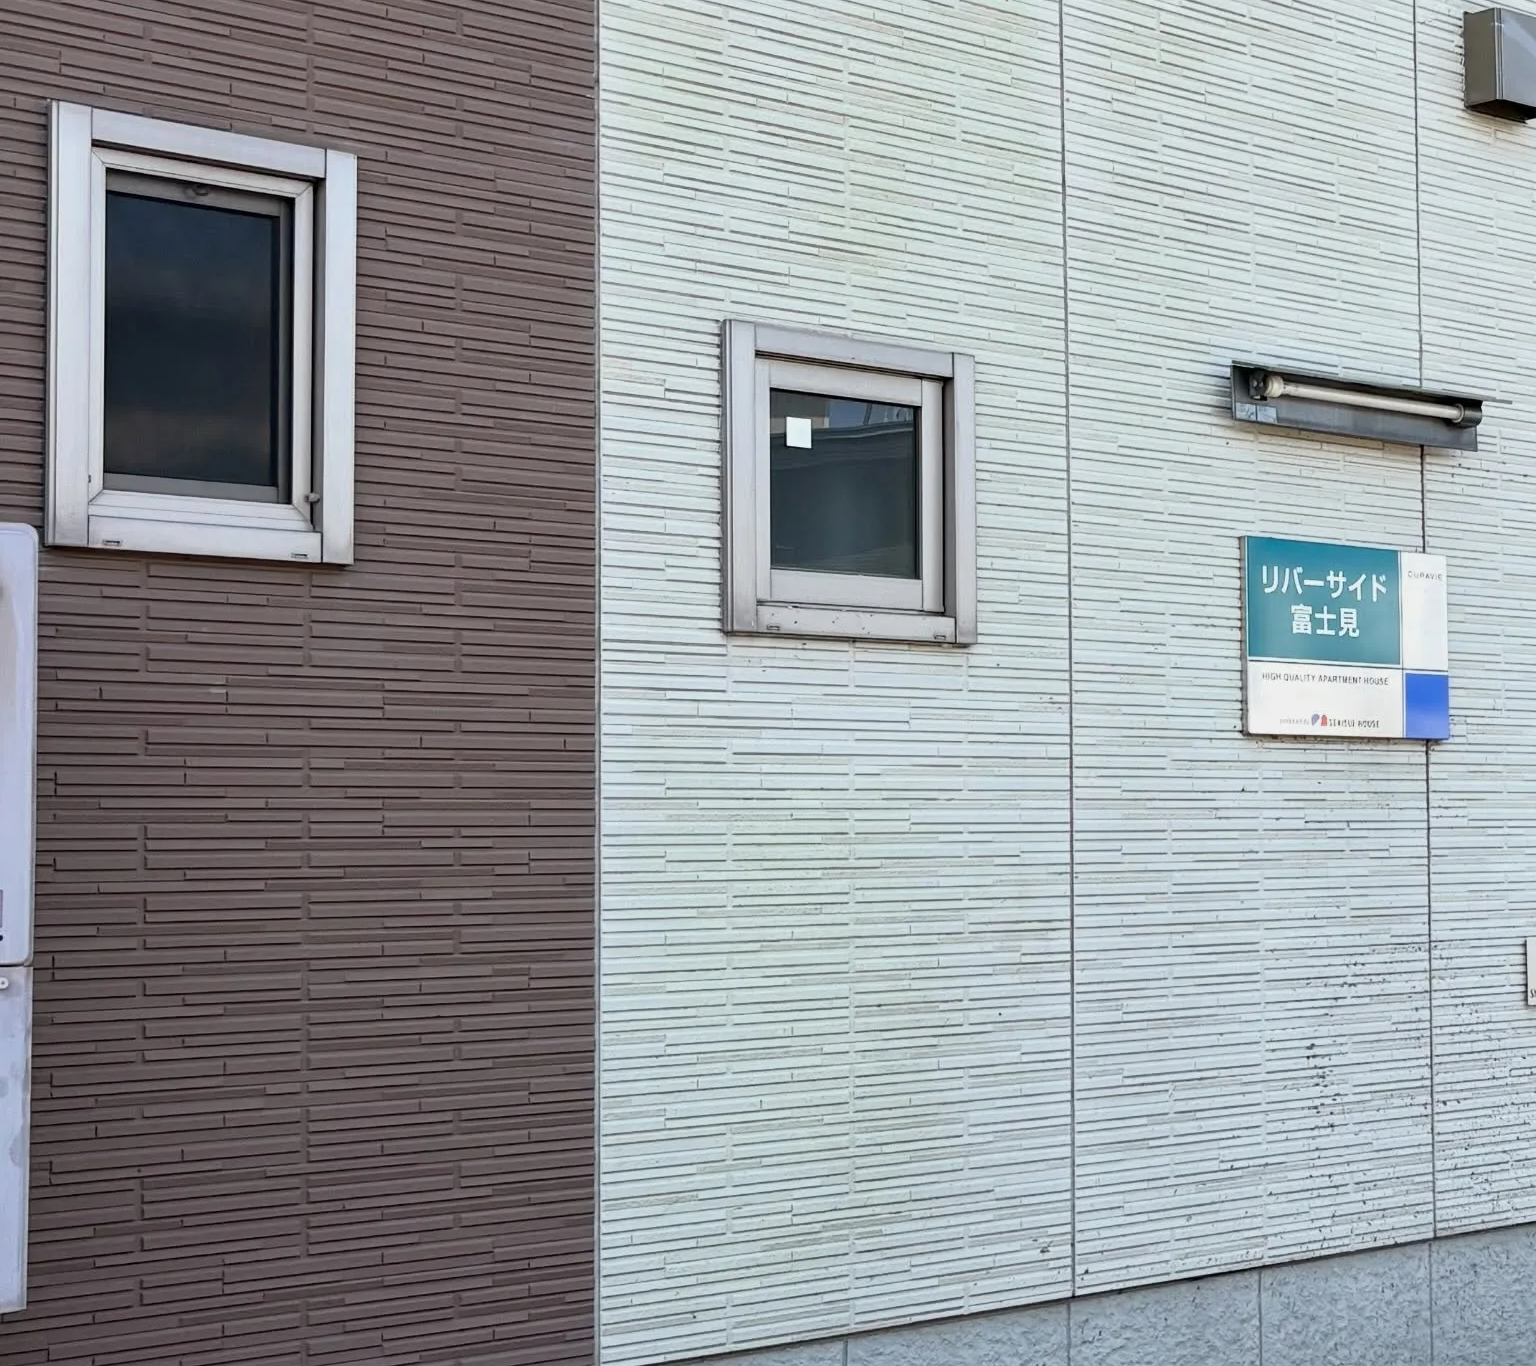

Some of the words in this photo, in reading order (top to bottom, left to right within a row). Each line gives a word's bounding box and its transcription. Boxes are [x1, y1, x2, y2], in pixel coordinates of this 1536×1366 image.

[1262, 565, 1387, 602] リバーサイド
[1290, 604, 1360, 638] 富士見
[1262, 672, 1281, 681] HIGH
[1283, 674, 1316, 682] QUALITY
[1318, 675, 1362, 684] APARTMENT
[1363, 676, 1389, 686] HOUSE
